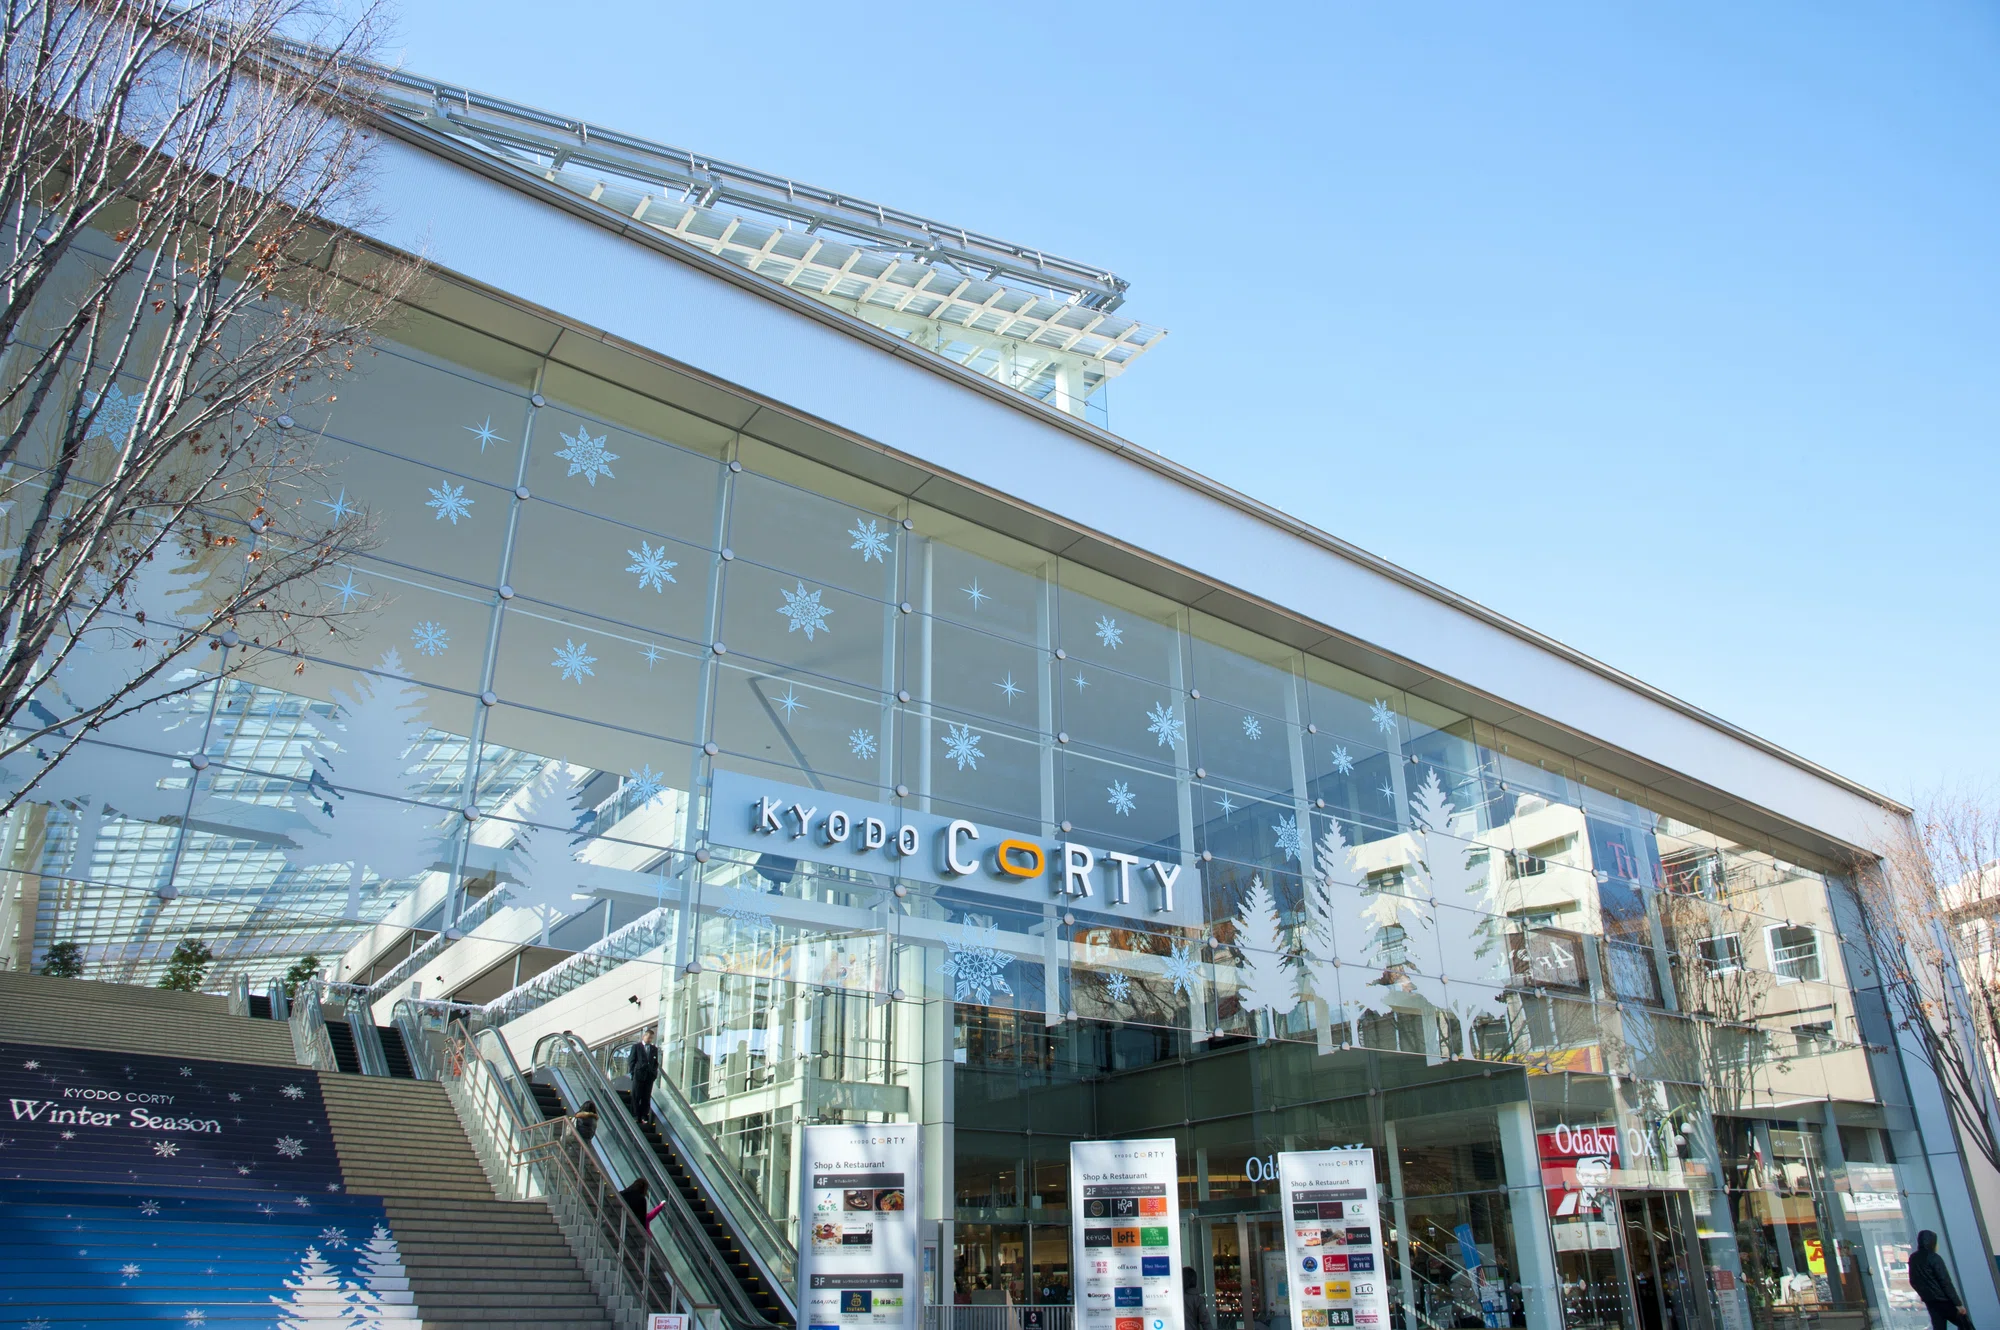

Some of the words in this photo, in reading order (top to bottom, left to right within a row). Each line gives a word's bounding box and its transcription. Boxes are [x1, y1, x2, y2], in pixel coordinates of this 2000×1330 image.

[758, 794, 919, 857] KYODO
[944, 818, 1182, 913] CORTY
[63, 1087, 122, 1102] KYODO
[126, 1092, 175, 1106] CORTY
[9, 1098, 121, 1128] Winter
[130, 1107, 223, 1134] Season
[871, 1137, 905, 1145] CORTY
[1628, 1128, 1658, 1157] OX
[814, 1161, 833, 1170] Shop
[817, 1177, 828, 1186] 4F
[1083, 1173, 1100, 1181] Shop
[1086, 1187, 1096, 1195] 2F
[814, 1277, 825, 1286] 3F
